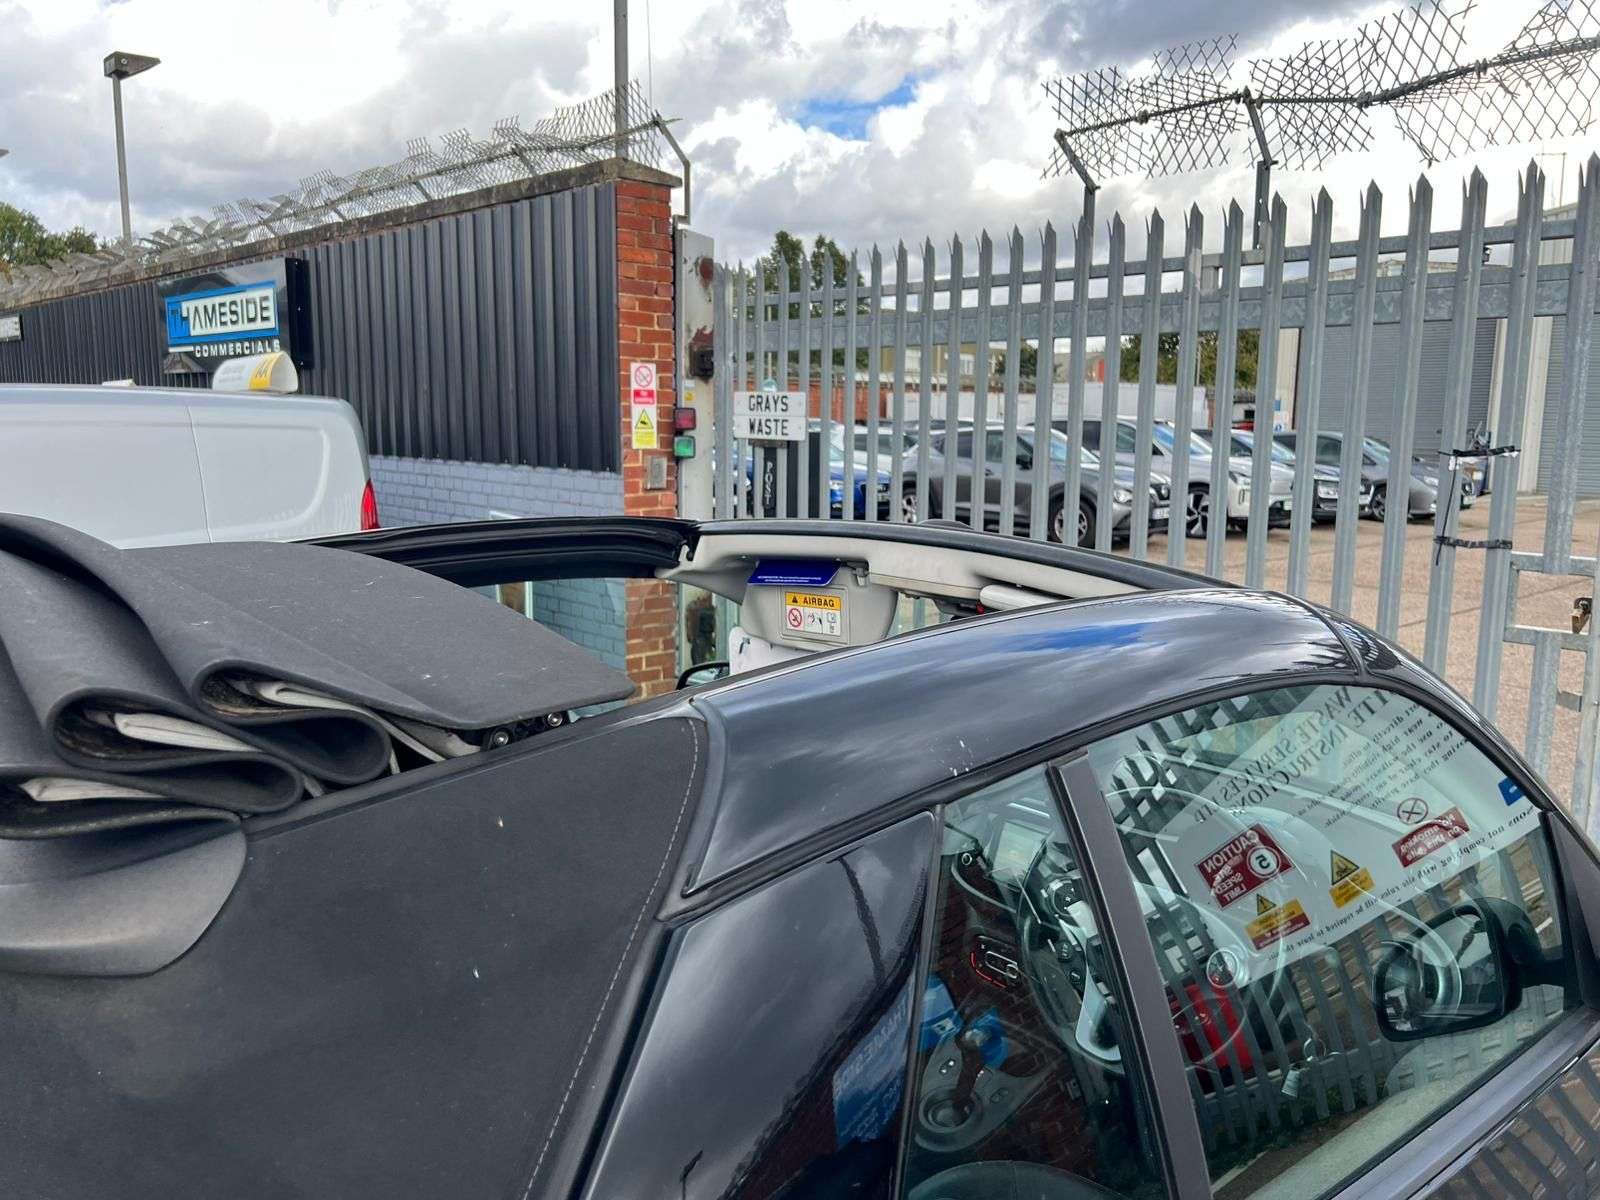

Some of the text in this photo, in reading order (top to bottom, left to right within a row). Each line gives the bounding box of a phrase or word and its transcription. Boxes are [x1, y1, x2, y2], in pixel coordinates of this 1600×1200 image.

[168, 295, 271, 333] THAMESIDE
[194, 338, 280, 358] COMMERCIALS
[748, 395, 789, 413] GRAYS
[749, 418, 789, 436] WASTE
[764, 461, 773, 505] POST
[803, 596, 835, 608] AIRBAG
